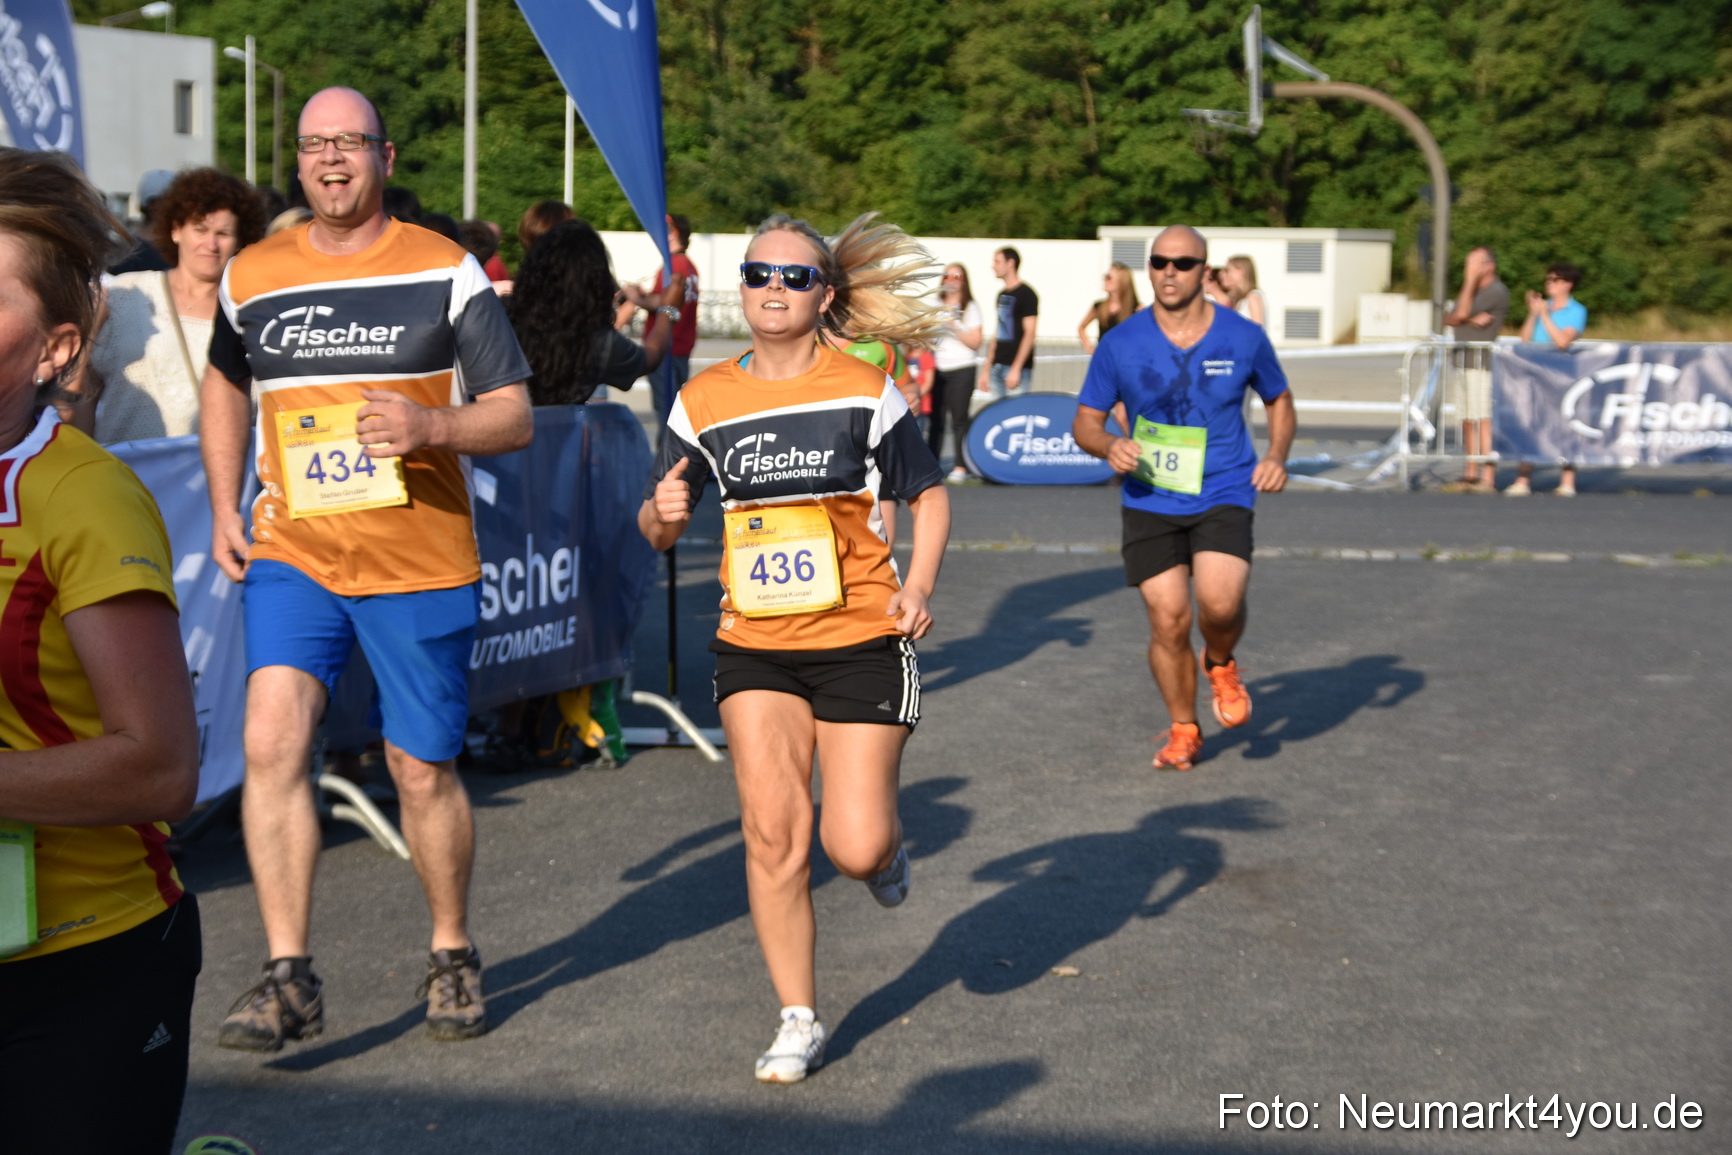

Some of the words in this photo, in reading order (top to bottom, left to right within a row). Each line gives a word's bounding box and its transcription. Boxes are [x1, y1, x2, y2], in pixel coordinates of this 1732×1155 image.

[280, 322, 405, 347] Fischer
[293, 344, 396, 359] AUTOMOBILE
[1600, 392, 1732, 430] Fisch
[1007, 432, 1080, 455] Fisch
[306, 445, 376, 484] 434
[740, 446, 834, 475] Fischer
[1152, 449, 1179, 471] 18
[750, 468, 827, 485] AUTOMOBILE
[750, 549, 815, 585] 436
[469, 615, 577, 670] UTOMOBILE
